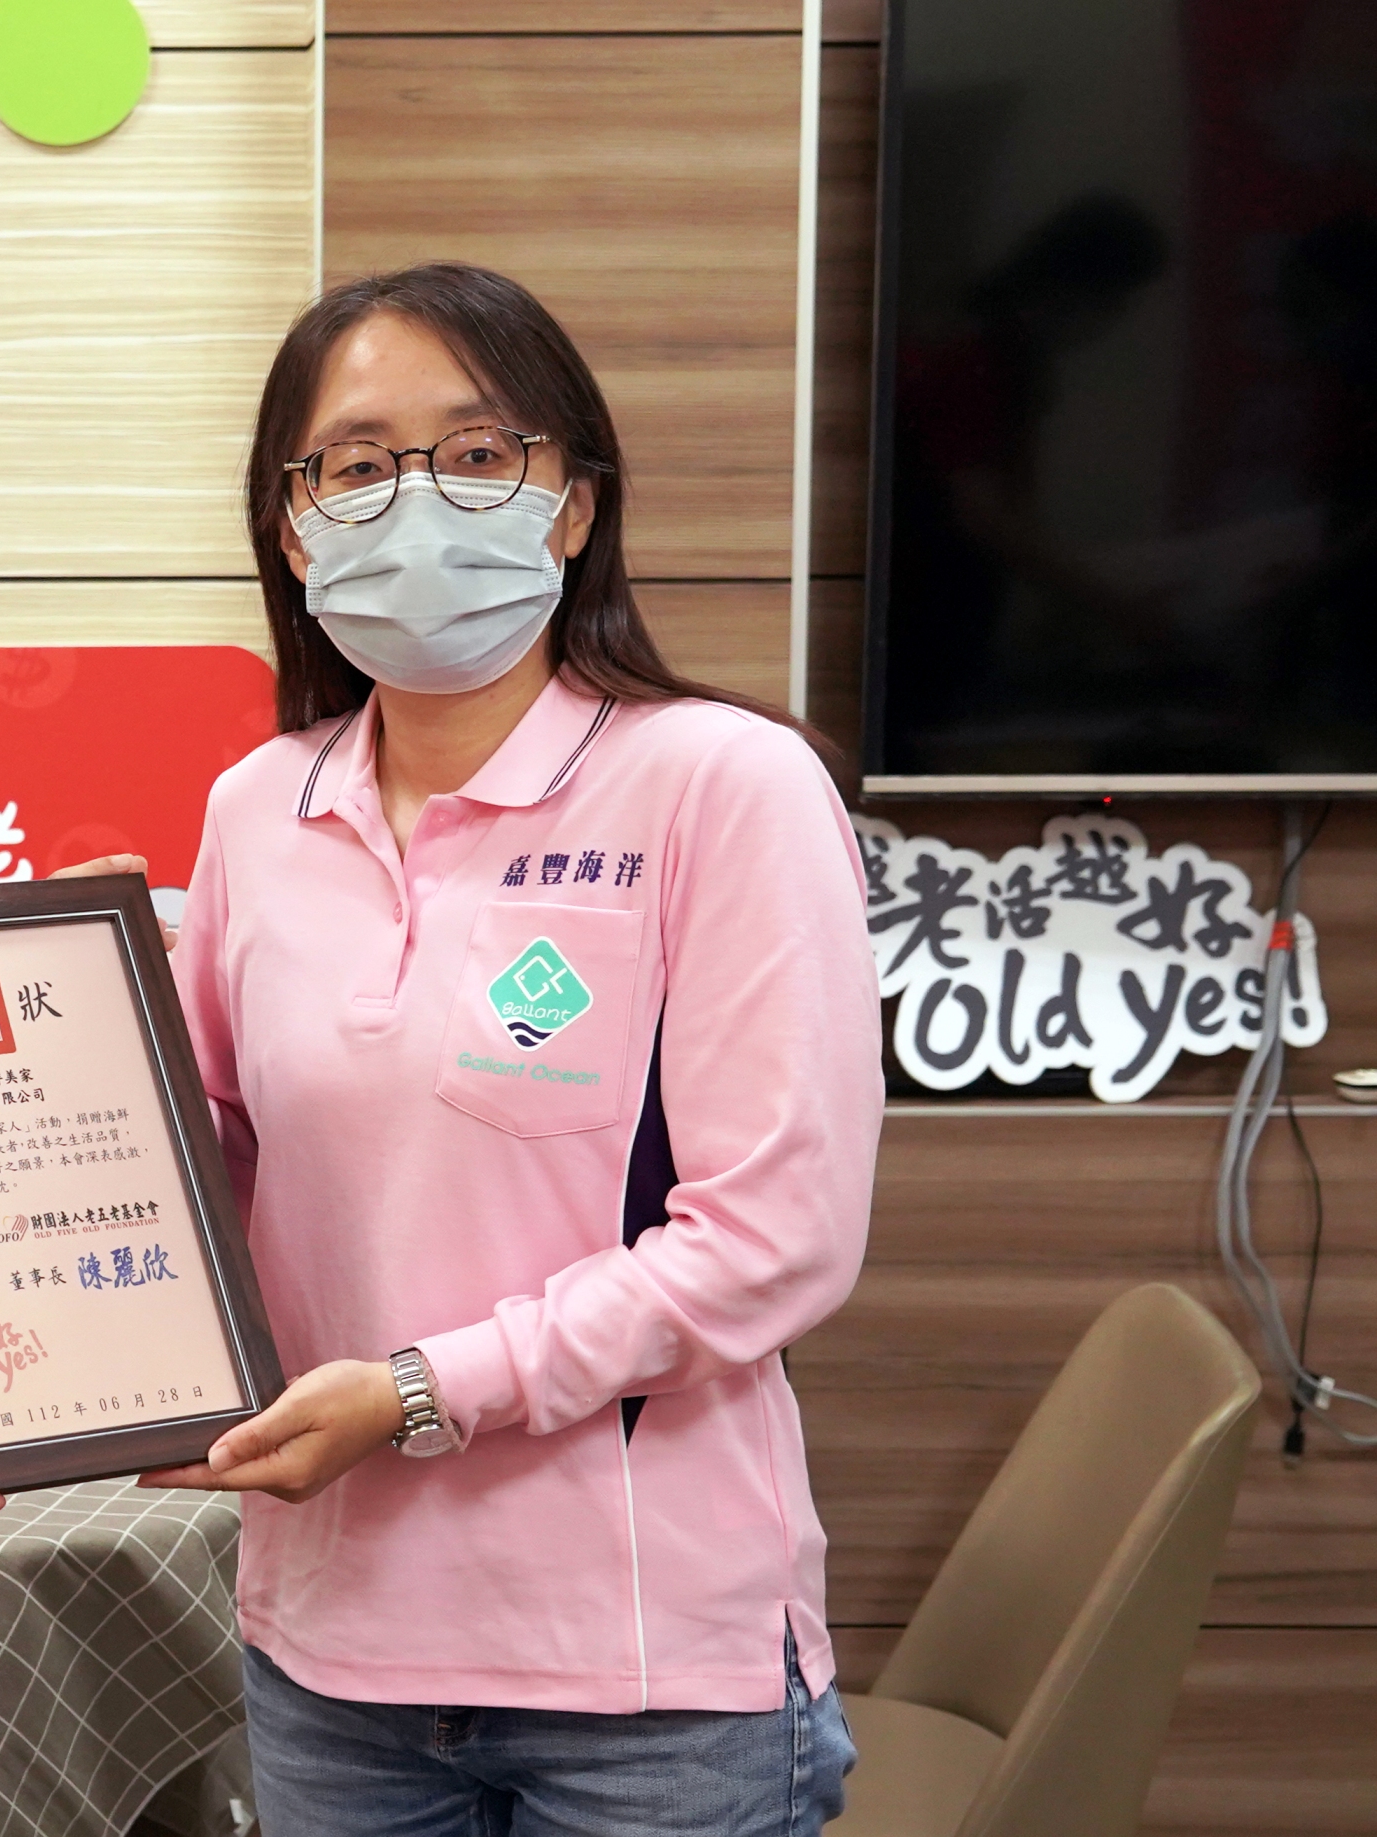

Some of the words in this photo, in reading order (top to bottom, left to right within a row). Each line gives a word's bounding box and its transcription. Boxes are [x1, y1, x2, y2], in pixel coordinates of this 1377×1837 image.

[500, 850, 644, 887] 嘉豐海洋
[920, 948, 1092, 1070] Old
[457, 1052, 525, 1078] Gallant
[531, 1064, 600, 1085] Ocean
[34, 1230, 52, 1239] OLD
[57, 1227, 77, 1236] FIVE
[83, 1224, 100, 1233] OLD
[105, 1217, 159, 1230] FOUNDATION
[9, 1266, 67, 1291] 董事長
[78, 1243, 178, 1290] 陳麗欣
